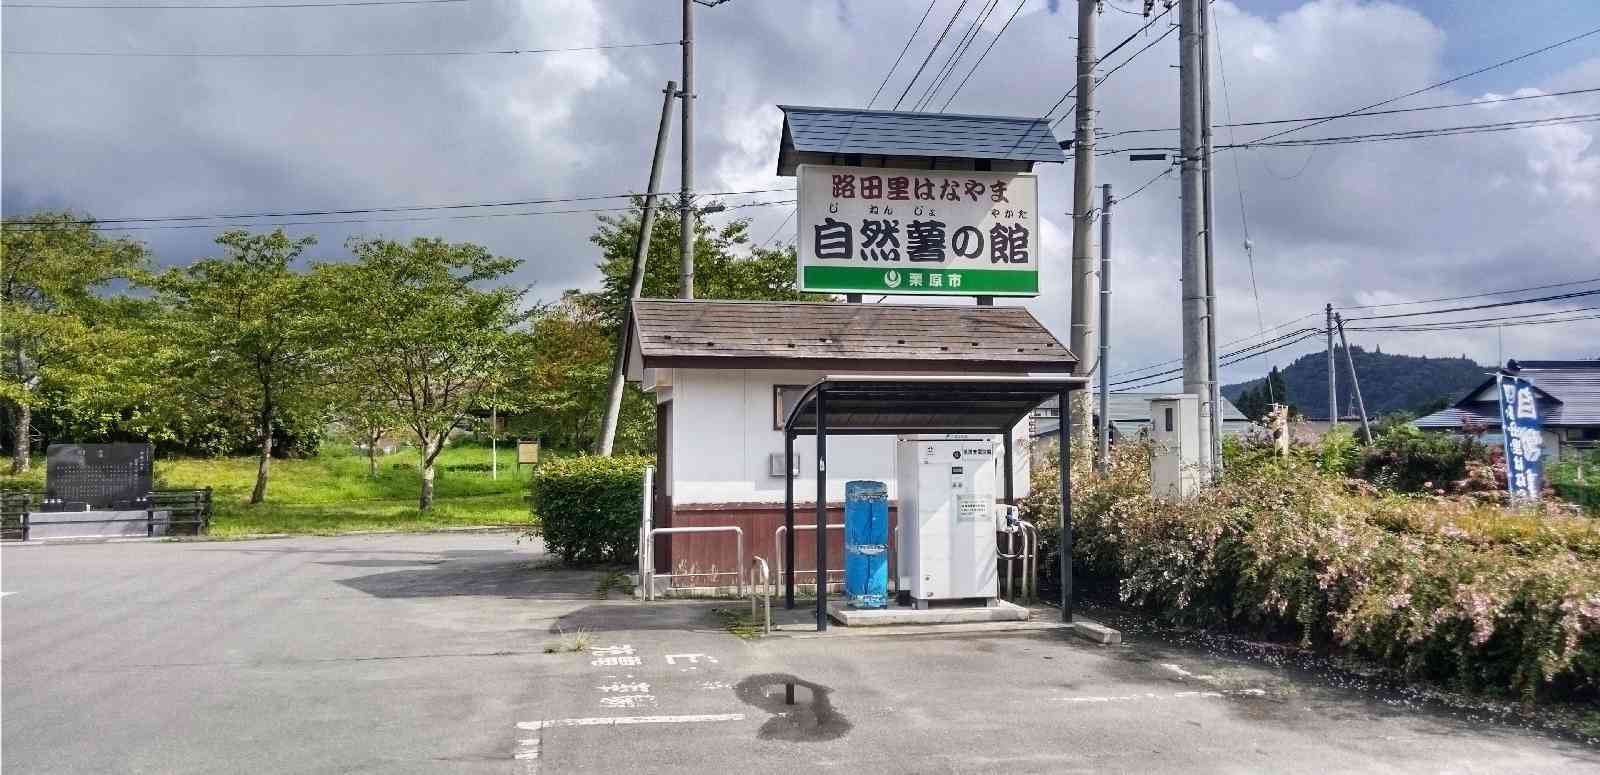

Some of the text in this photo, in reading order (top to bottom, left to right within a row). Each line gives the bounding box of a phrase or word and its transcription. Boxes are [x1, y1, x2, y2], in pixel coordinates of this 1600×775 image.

[832, 174, 1009, 203] 路田里はなやま
[814, 217, 1030, 264] 自然薯の館
[909, 271, 962, 288] 栗原市
